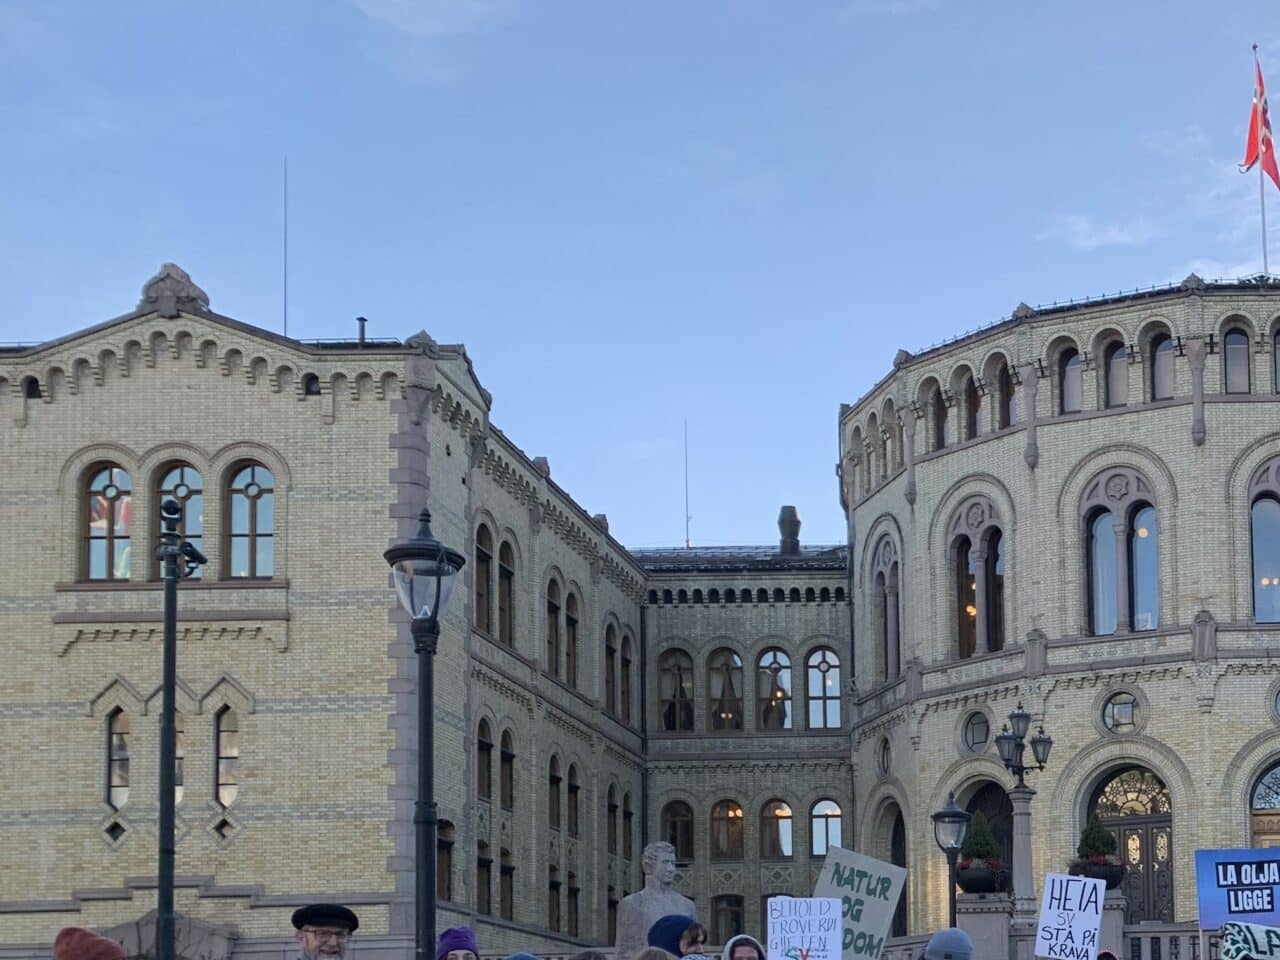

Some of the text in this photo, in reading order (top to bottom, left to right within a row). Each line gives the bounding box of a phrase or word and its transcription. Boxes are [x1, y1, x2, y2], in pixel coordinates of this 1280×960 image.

[830, 862, 891, 900] NATUR
[1216, 862, 1280, 886] LA OLJA
[1048, 878, 1099, 915] HEIA
[1229, 890, 1272, 912] LIGGE
[769, 900, 832, 919] BEHOLD
[1057, 912, 1076, 926] SV
[1041, 925, 1098, 947] STÅ PÅ
[1048, 942, 1089, 960] KRAVA
